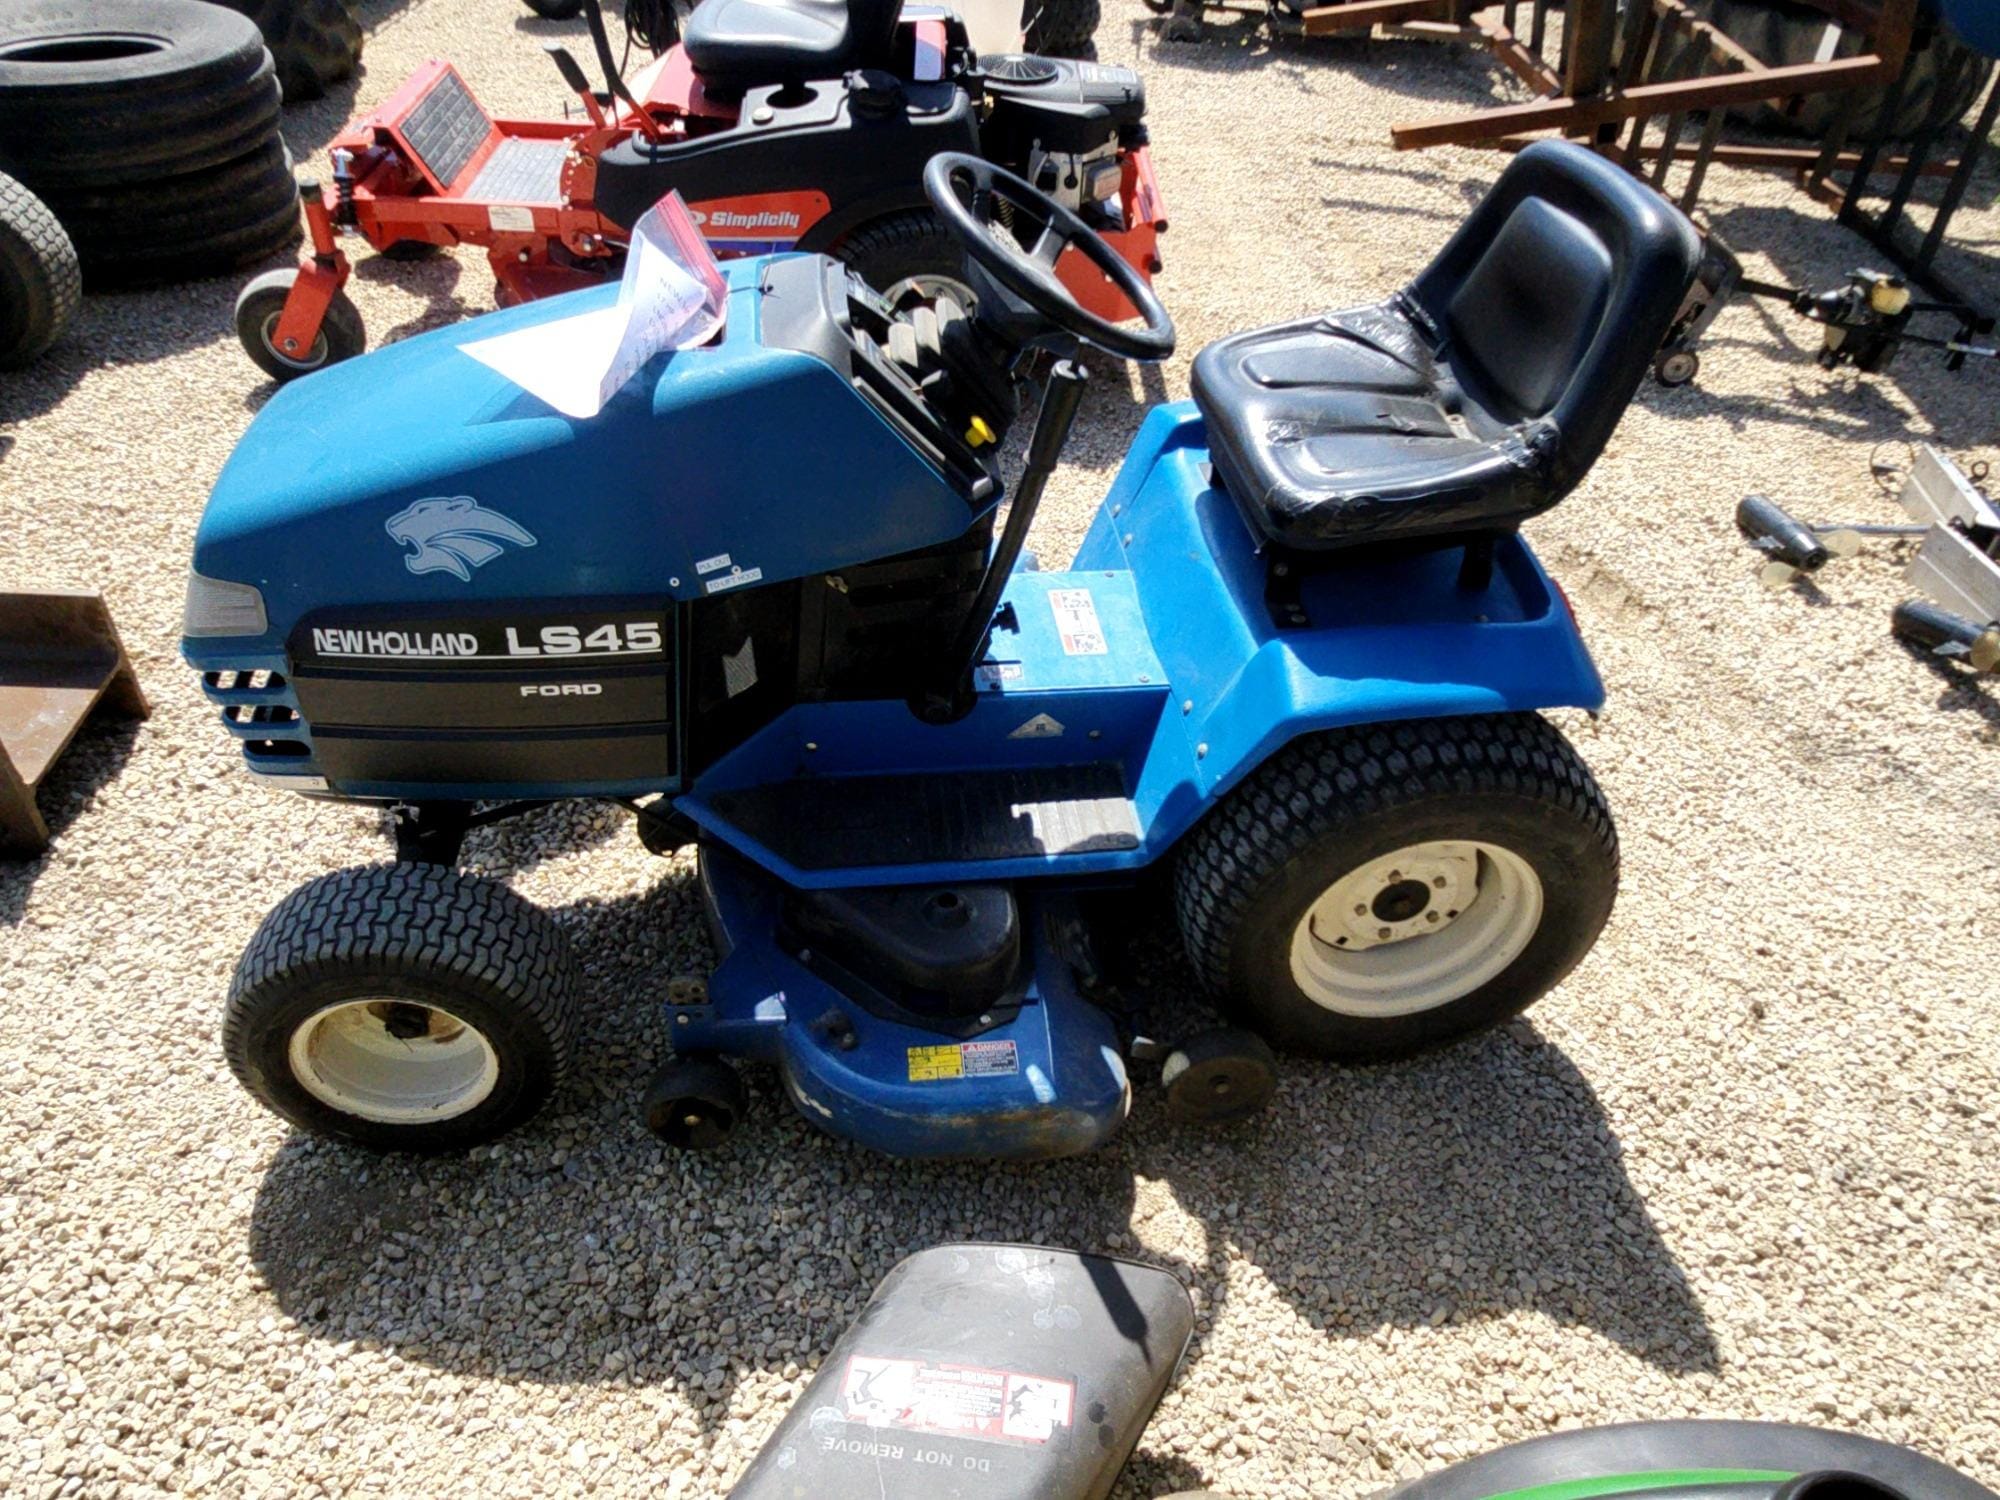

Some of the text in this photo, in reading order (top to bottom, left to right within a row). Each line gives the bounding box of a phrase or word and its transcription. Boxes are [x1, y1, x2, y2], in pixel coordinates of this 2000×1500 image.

[711, 211, 800, 229] Simplicity
[312, 622, 662, 656] NEW HOLLAND LS45
[520, 684, 602, 697] FORD
[822, 1436, 991, 1473] DO NOT REMOVE
